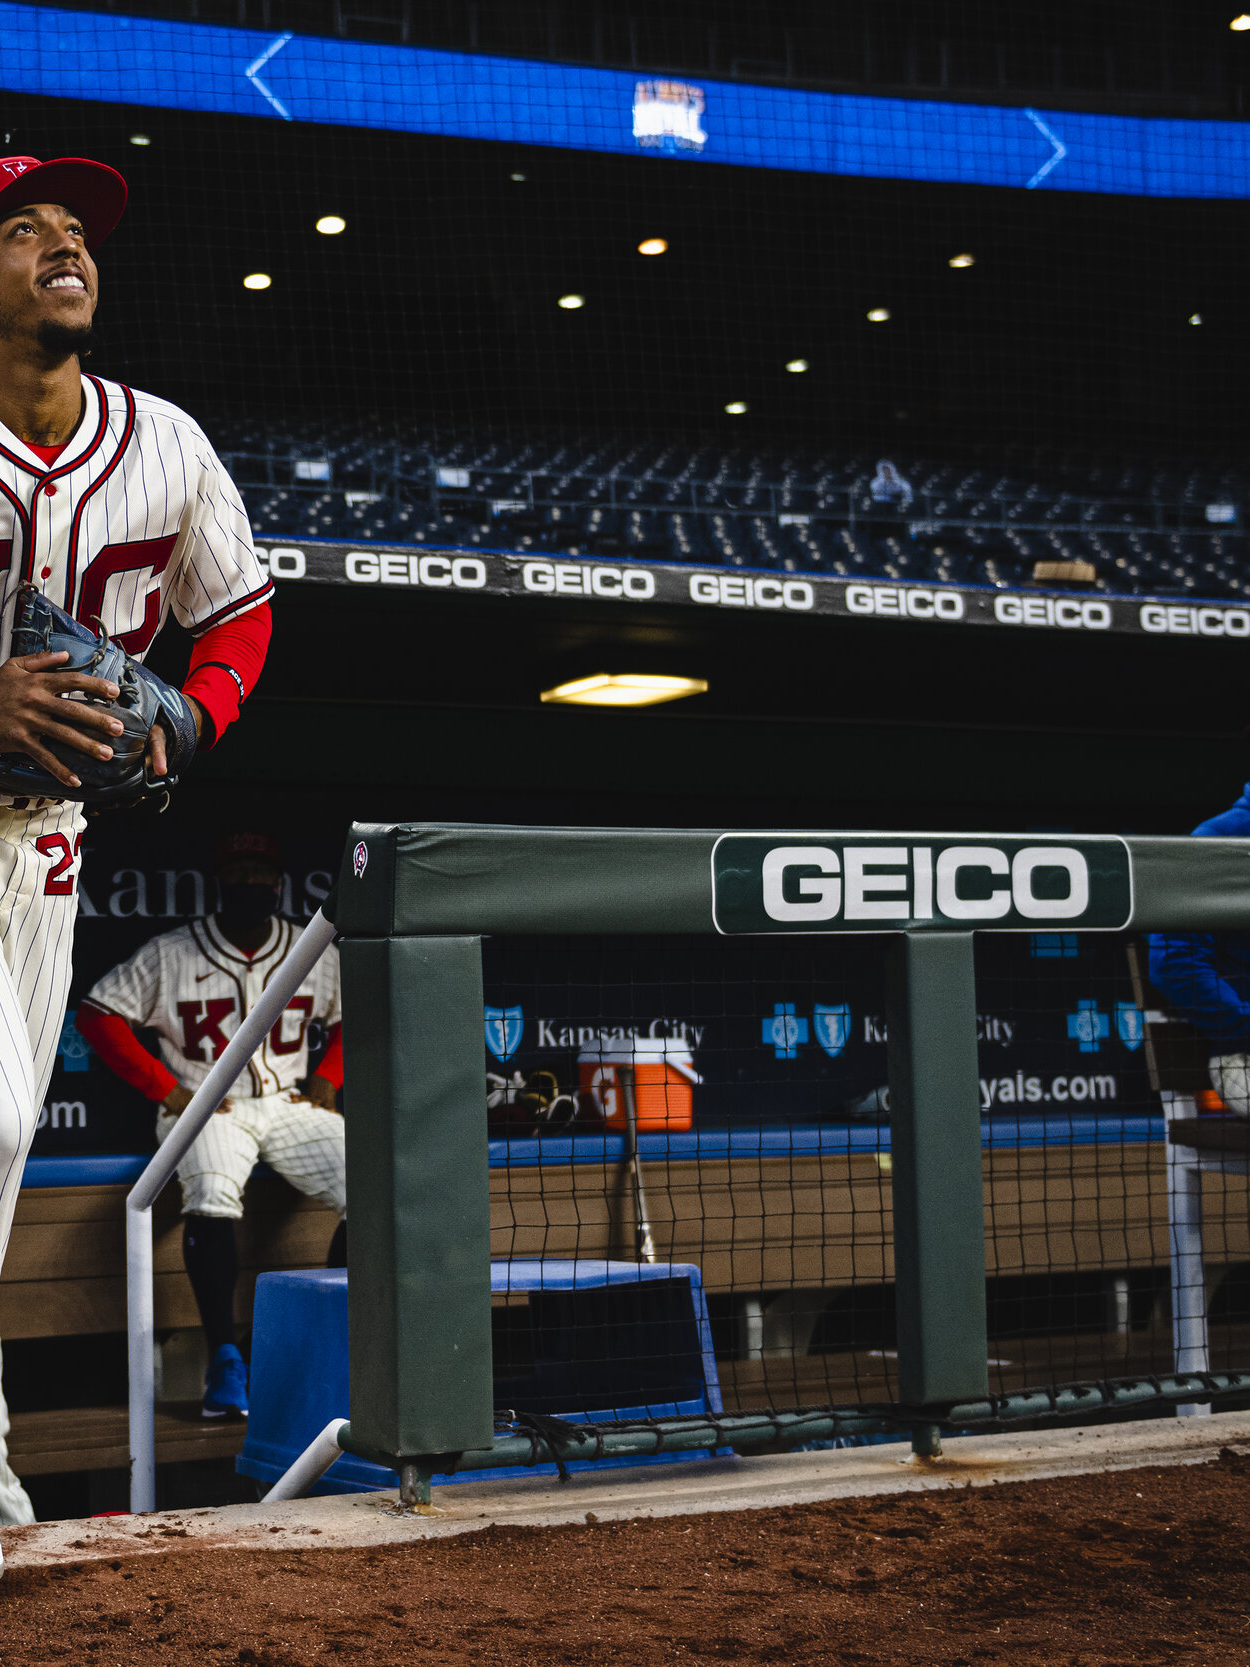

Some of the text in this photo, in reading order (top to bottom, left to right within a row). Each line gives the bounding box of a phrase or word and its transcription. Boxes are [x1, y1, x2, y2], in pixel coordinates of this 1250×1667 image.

[344, 551, 487, 588] GEICO
[522, 561, 656, 599] GEICO
[689, 573, 814, 610] GEICO
[845, 584, 964, 620] GEICO
[993, 594, 1112, 630] GEICO
[1139, 603, 1250, 637] GEICO
[762, 846, 1090, 922] GEICO
[590, 1065, 618, 1119] G
